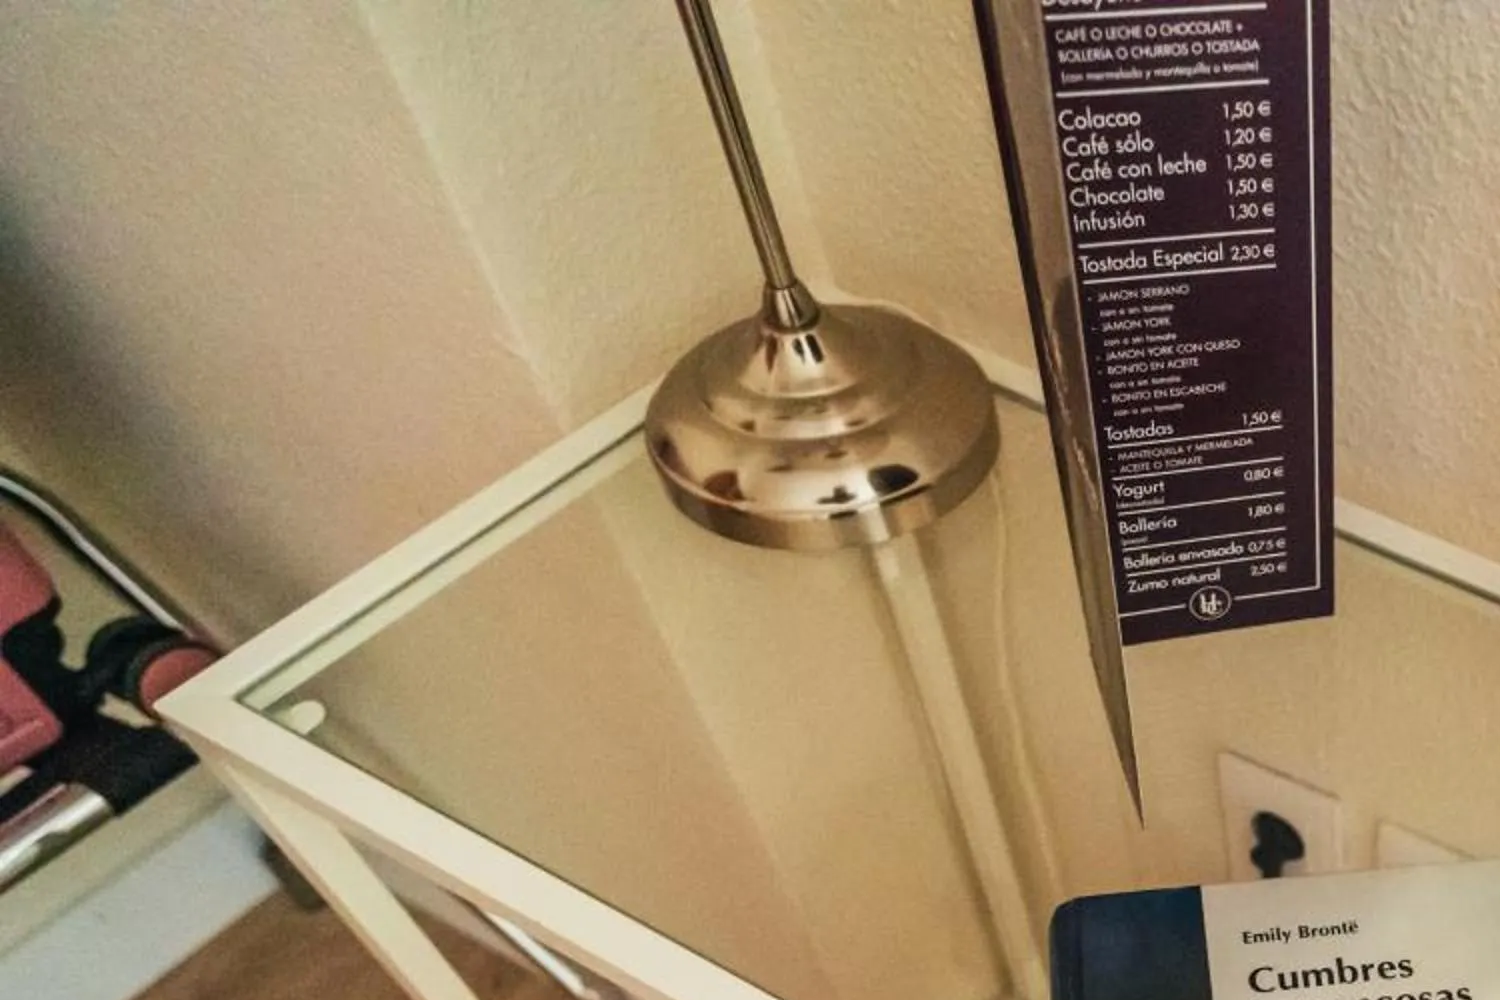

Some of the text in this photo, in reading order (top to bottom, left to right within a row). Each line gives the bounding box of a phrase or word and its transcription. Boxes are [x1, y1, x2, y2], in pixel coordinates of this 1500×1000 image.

[1091, 28, 1103, 41] O
[1105, 25, 1142, 40] LECHE
[1145, 25, 1157, 38] O
[1160, 20, 1233, 37] CHOCOLATE
[1116, 47, 1128, 60] O
[1131, 42, 1188, 59] CHURROS
[1192, 42, 1204, 55] O
[1206, 39, 1260, 54] TOSTADA
[1058, 100, 1272, 131] Colacao 1,50 €
[1062, 126, 1272, 158] Café sólo 1,20 €
[1065, 152, 1273, 184] Café con leche 1,50 €
[1069, 178, 1274, 207] Chocolate 1,50 €
[1073, 202, 1275, 233] Infusión 1,30 €
[1079, 242, 1275, 274] Tostada Especial 2,30 €
[1140, 284, 1190, 299] SERRANO
[1144, 316, 1172, 328] YORK
[1147, 345, 1174, 357] YORK
[1176, 342, 1202, 355] CON
[1204, 338, 1241, 352] QUESO
[1107, 357, 1200, 375] BONITO EN ACEITE
[1111, 381, 1227, 404] BONITO EN ESCABECHE
[1104, 420, 1174, 441] Tostadas
[1242, 411, 1268, 427] 1,50
[1153, 460, 1163, 470] O
[1112, 480, 1166, 500] Yogurt
[1119, 515, 1178, 535] Bollería
[1123, 550, 1176, 570] Bollería
[1128, 579, 1169, 594] Zumo
[1171, 566, 1222, 587] natural
[1242, 920, 1359, 945] Emily Brontë
[1248, 957, 1414, 993] Cumbres
